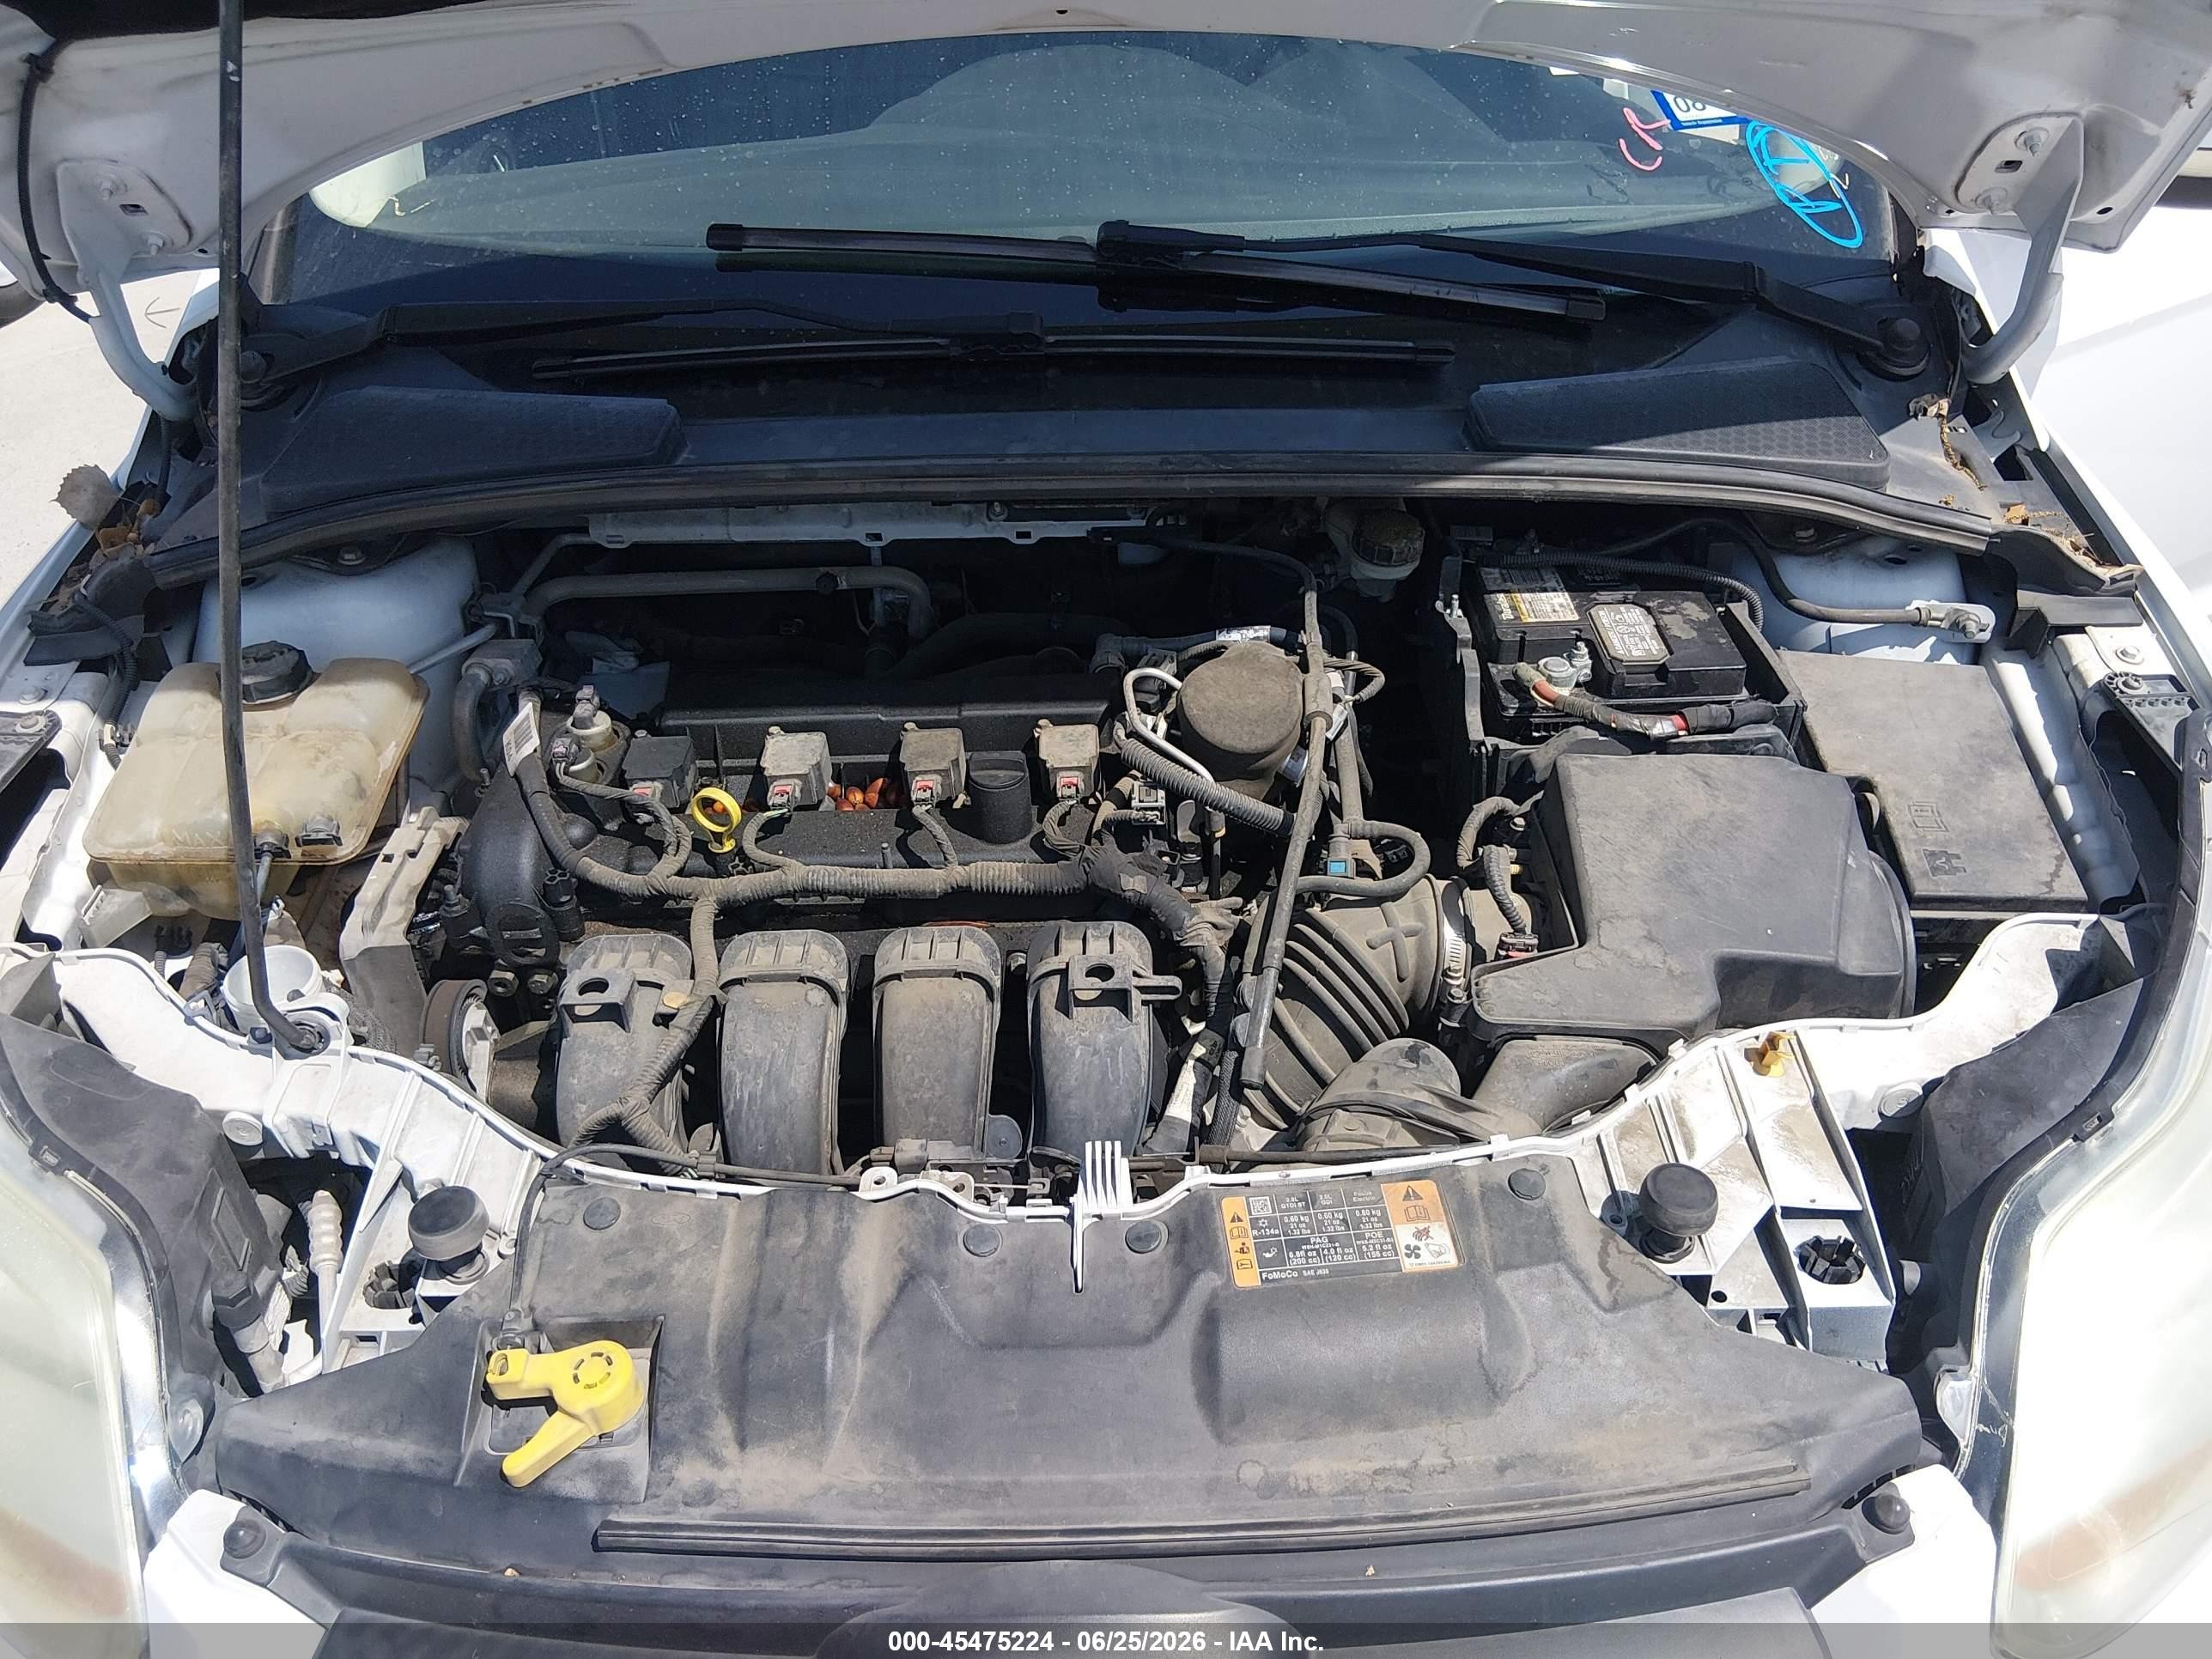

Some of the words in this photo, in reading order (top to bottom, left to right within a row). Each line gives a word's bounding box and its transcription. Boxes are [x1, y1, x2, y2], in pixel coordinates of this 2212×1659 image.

[1371, 1208, 1382, 1217] kg
[1252, 1228, 1279, 1237] R-134a
[1364, 1231, 1384, 1239] POE
[1325, 1254, 1342, 1263] (120
[1364, 1251, 1381, 1260] (155
[1382, 1249, 1395, 1258] cc)
[1290, 1257, 1306, 1267] (200
[1261, 1270, 1298, 1280] FoMoCo
